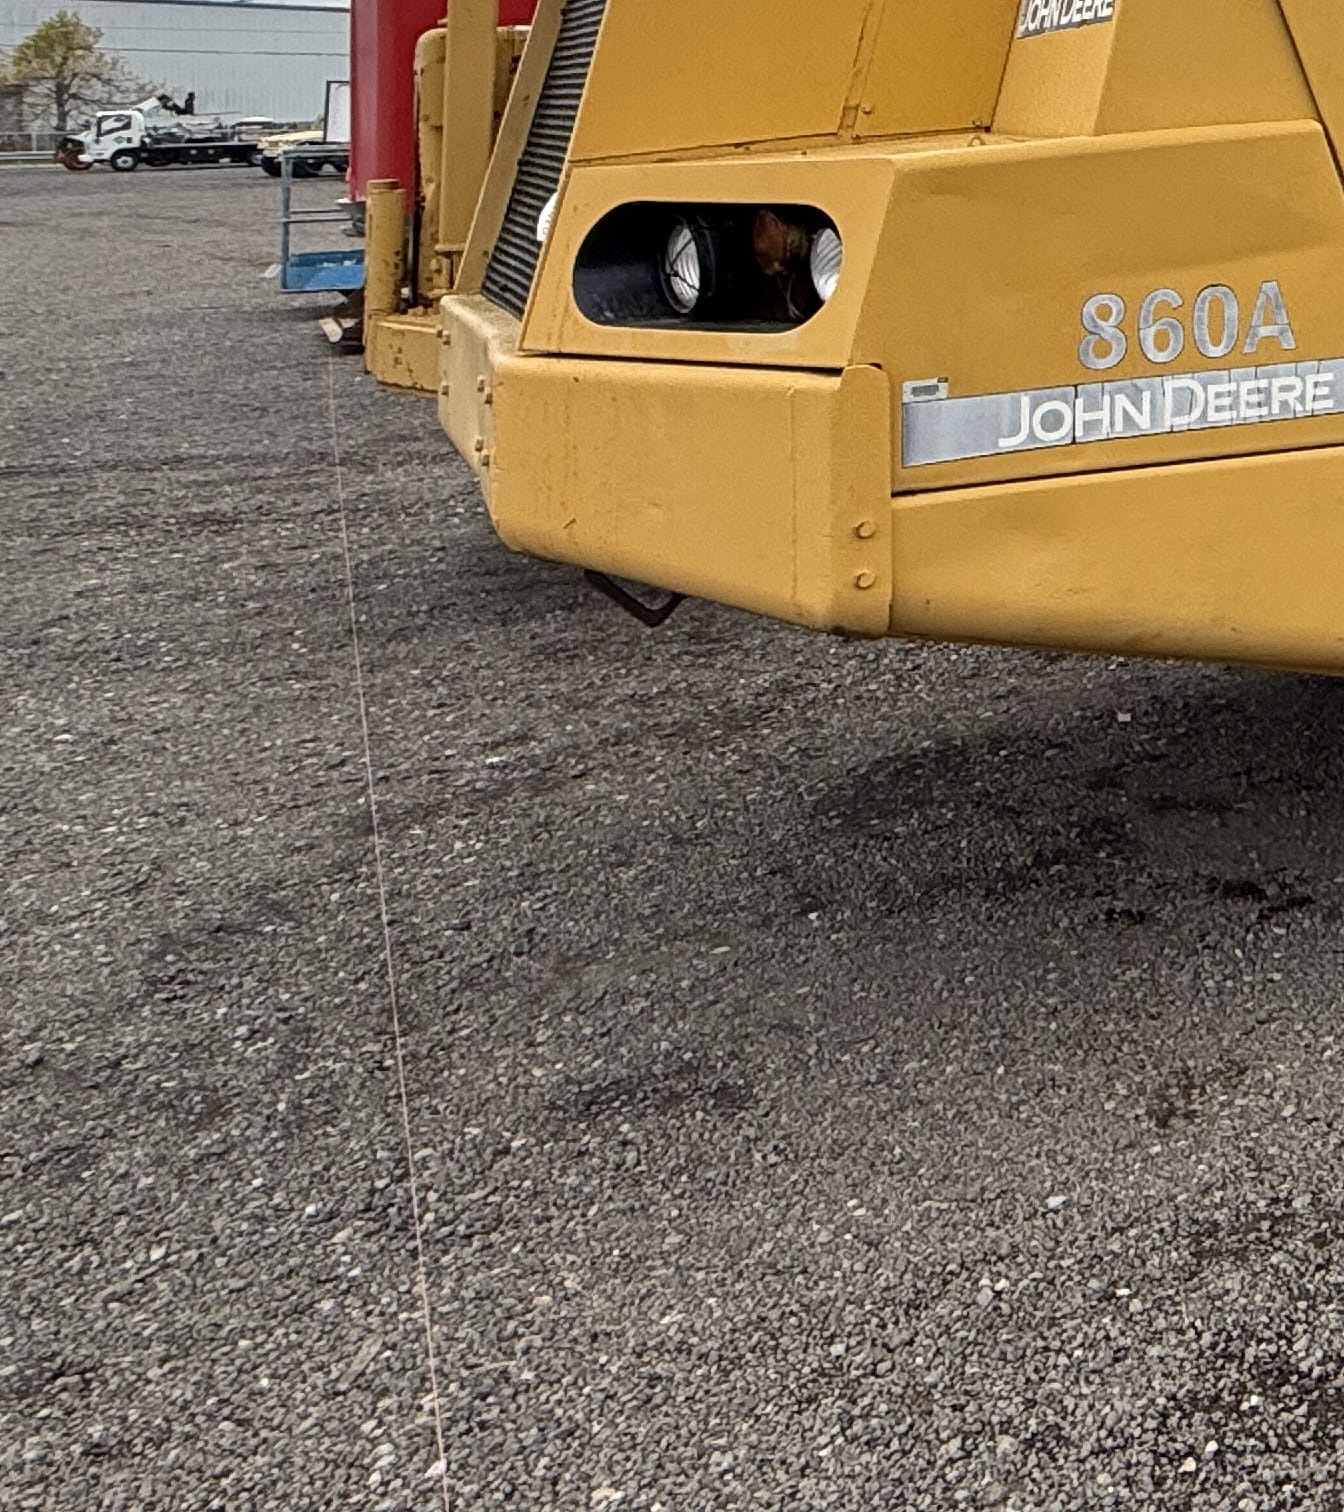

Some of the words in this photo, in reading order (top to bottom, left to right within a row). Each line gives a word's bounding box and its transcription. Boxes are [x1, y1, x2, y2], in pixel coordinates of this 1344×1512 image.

[1077, 280, 1296, 370] 860A
[998, 390, 1151, 448] JOHN
[1162, 372, 1335, 426] DEERE
